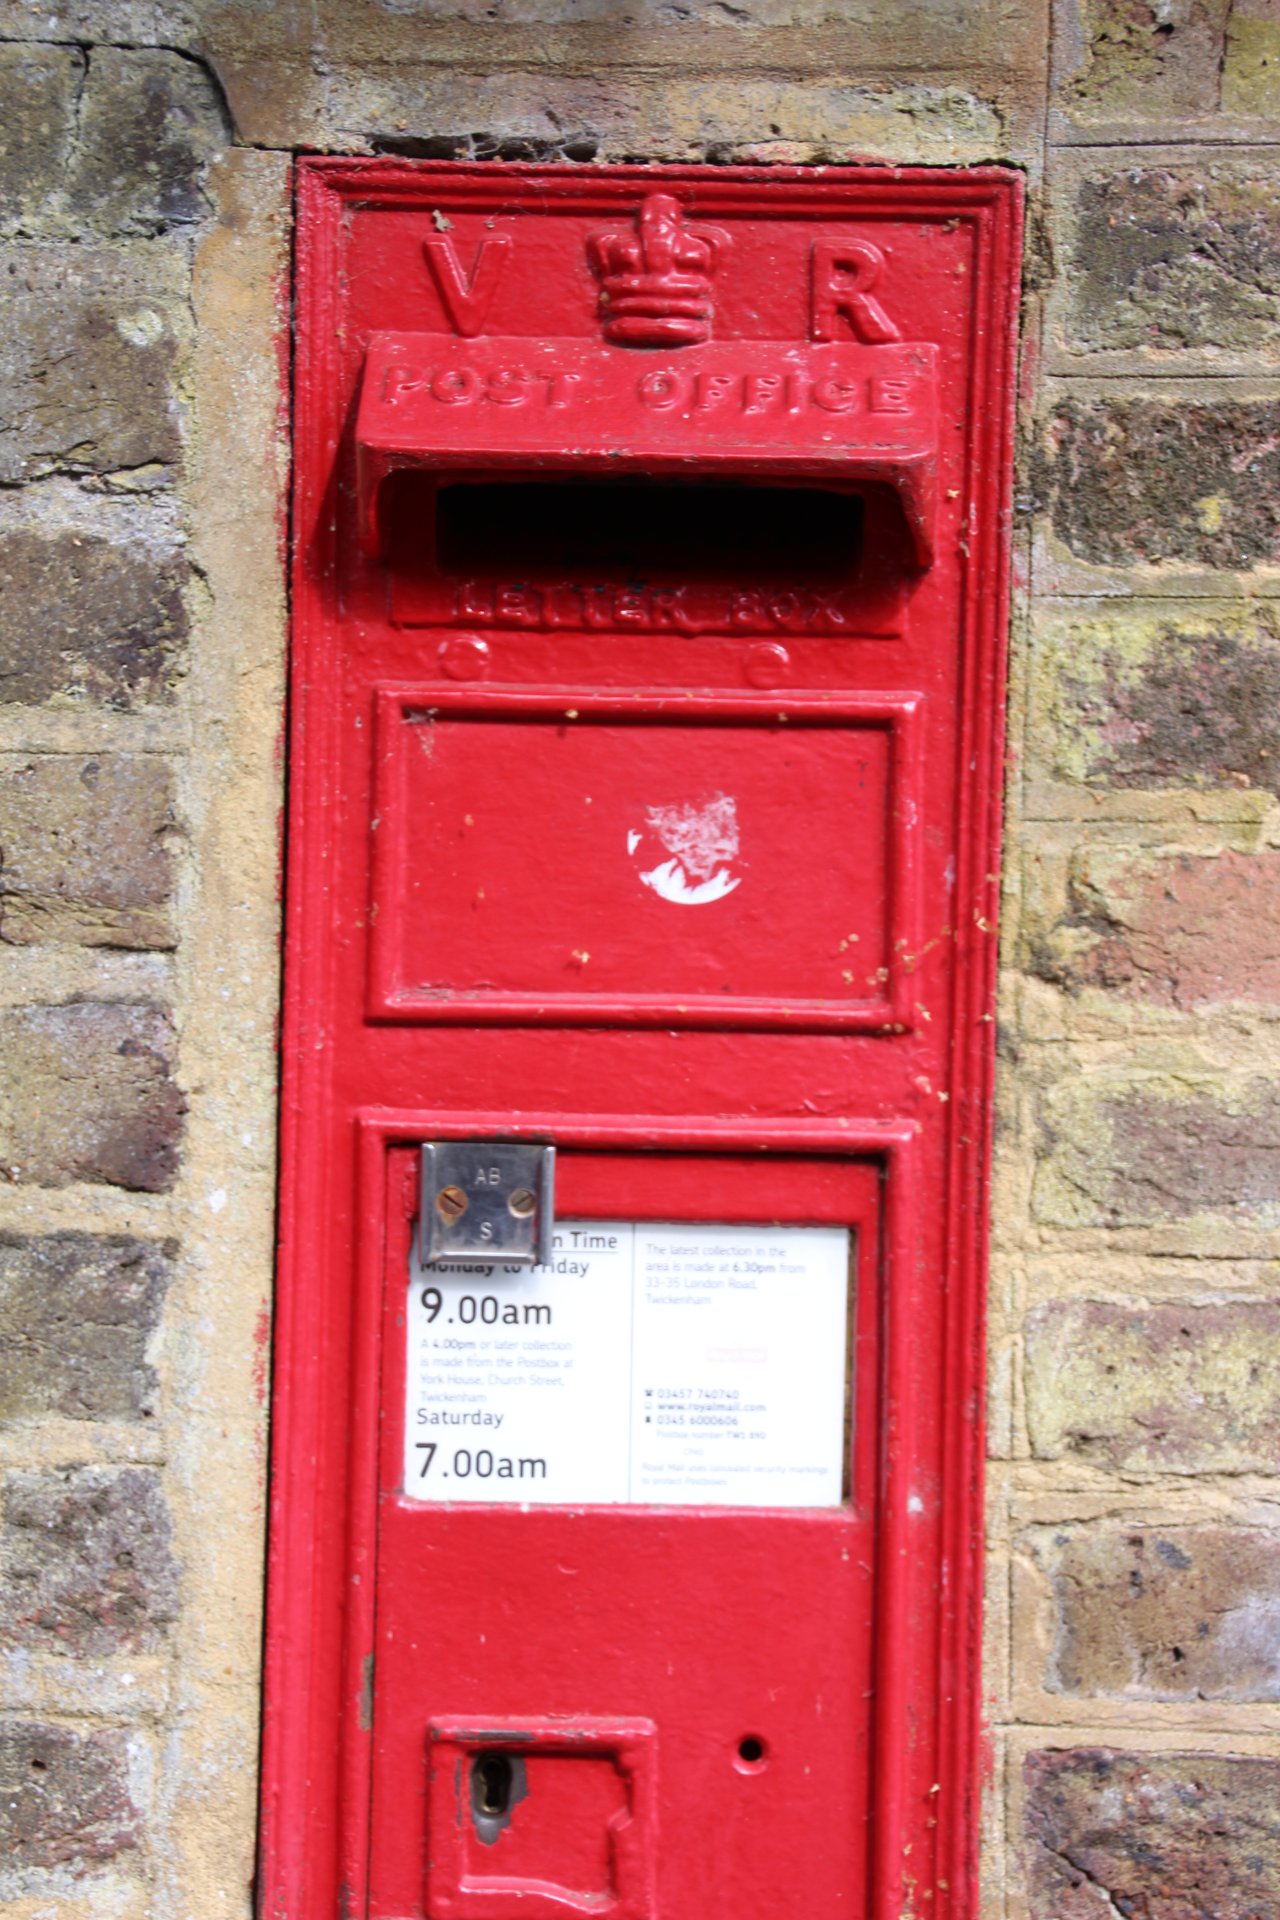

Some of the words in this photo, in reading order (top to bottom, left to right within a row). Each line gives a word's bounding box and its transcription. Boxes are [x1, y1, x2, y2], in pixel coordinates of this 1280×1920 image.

[424, 233, 512, 338] V
[810, 236, 900, 344] R
[384, 366, 582, 408] POST
[638, 370, 912, 415] OFFICE
[727, 586, 848, 628] BOX
[474, 1167, 502, 1185] AB
[480, 1222, 493, 1240] S
[570, 1231, 618, 1248] Time
[531, 1259, 589, 1277] Friday
[421, 1287, 552, 1325] 9.00am
[416, 1408, 504, 1429] Saturday
[415, 1443, 547, 1478] 7.00am
